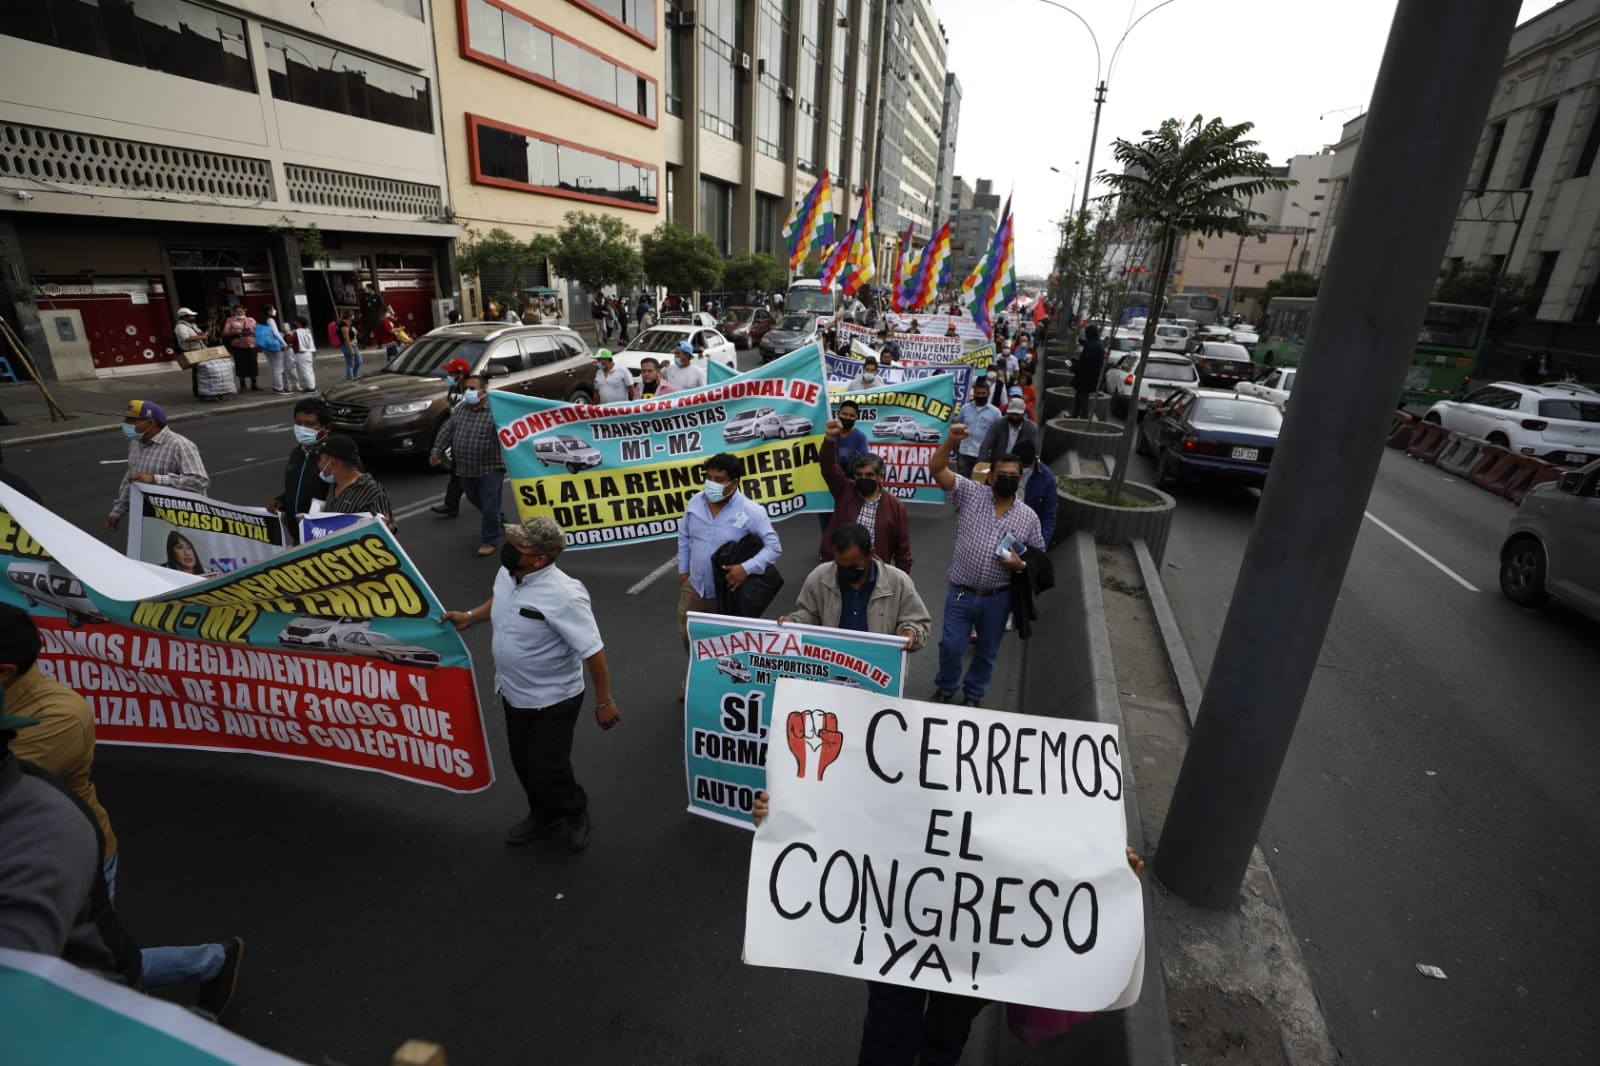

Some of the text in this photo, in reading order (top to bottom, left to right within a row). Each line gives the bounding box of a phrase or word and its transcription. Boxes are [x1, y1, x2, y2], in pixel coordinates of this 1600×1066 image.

[894, 340, 961, 354] ONSTITUYENTES
[910, 334, 960, 344] PRESIDENTE
[833, 360, 889, 381] ALIAZA
[900, 350, 959, 362] URINACIONAL
[678, 380, 785, 407] NACIONAL
[790, 380, 819, 404] DE
[844, 392, 925, 411] NACIONAL
[928, 400, 951, 420] DE
[591, 404, 727, 439] TRANSPORTISTAS
[622, 439, 652, 461] M1
[668, 431, 702, 455] M2
[519, 441, 820, 507] SÍ, A LA REINGIERÍA
[149, 495, 266, 527] REFORMA DEL TRANSPORTE
[553, 473, 794, 528] DEL TRANSRTE
[226, 519, 271, 543] TOTAL
[566, 519, 682, 546] OORDINADO
[187, 537, 398, 603] RANSPORTISTAS
[39, 628, 429, 701] EDIMOS LA REGLAMENTACIÓN Y
[697, 632, 890, 687] ALIANZA NACIONAL DE
[750, 655, 829, 677] TRANSPORTISTAS
[756, 670, 771, 684] M1
[38, 659, 454, 741] BLICACIÓN DE LA LEY 31096 QUE
[723, 693, 768, 738] SÍ,
[149, 699, 168, 728] A
[171, 701, 220, 733] LOS
[223, 710, 309, 745] AUTOS
[308, 725, 474, 778] COLECTIVOS
[865, 708, 1123, 801] CERREMOS
[924, 808, 984, 862] EL
[769, 842, 1099, 955] CONGRESO
